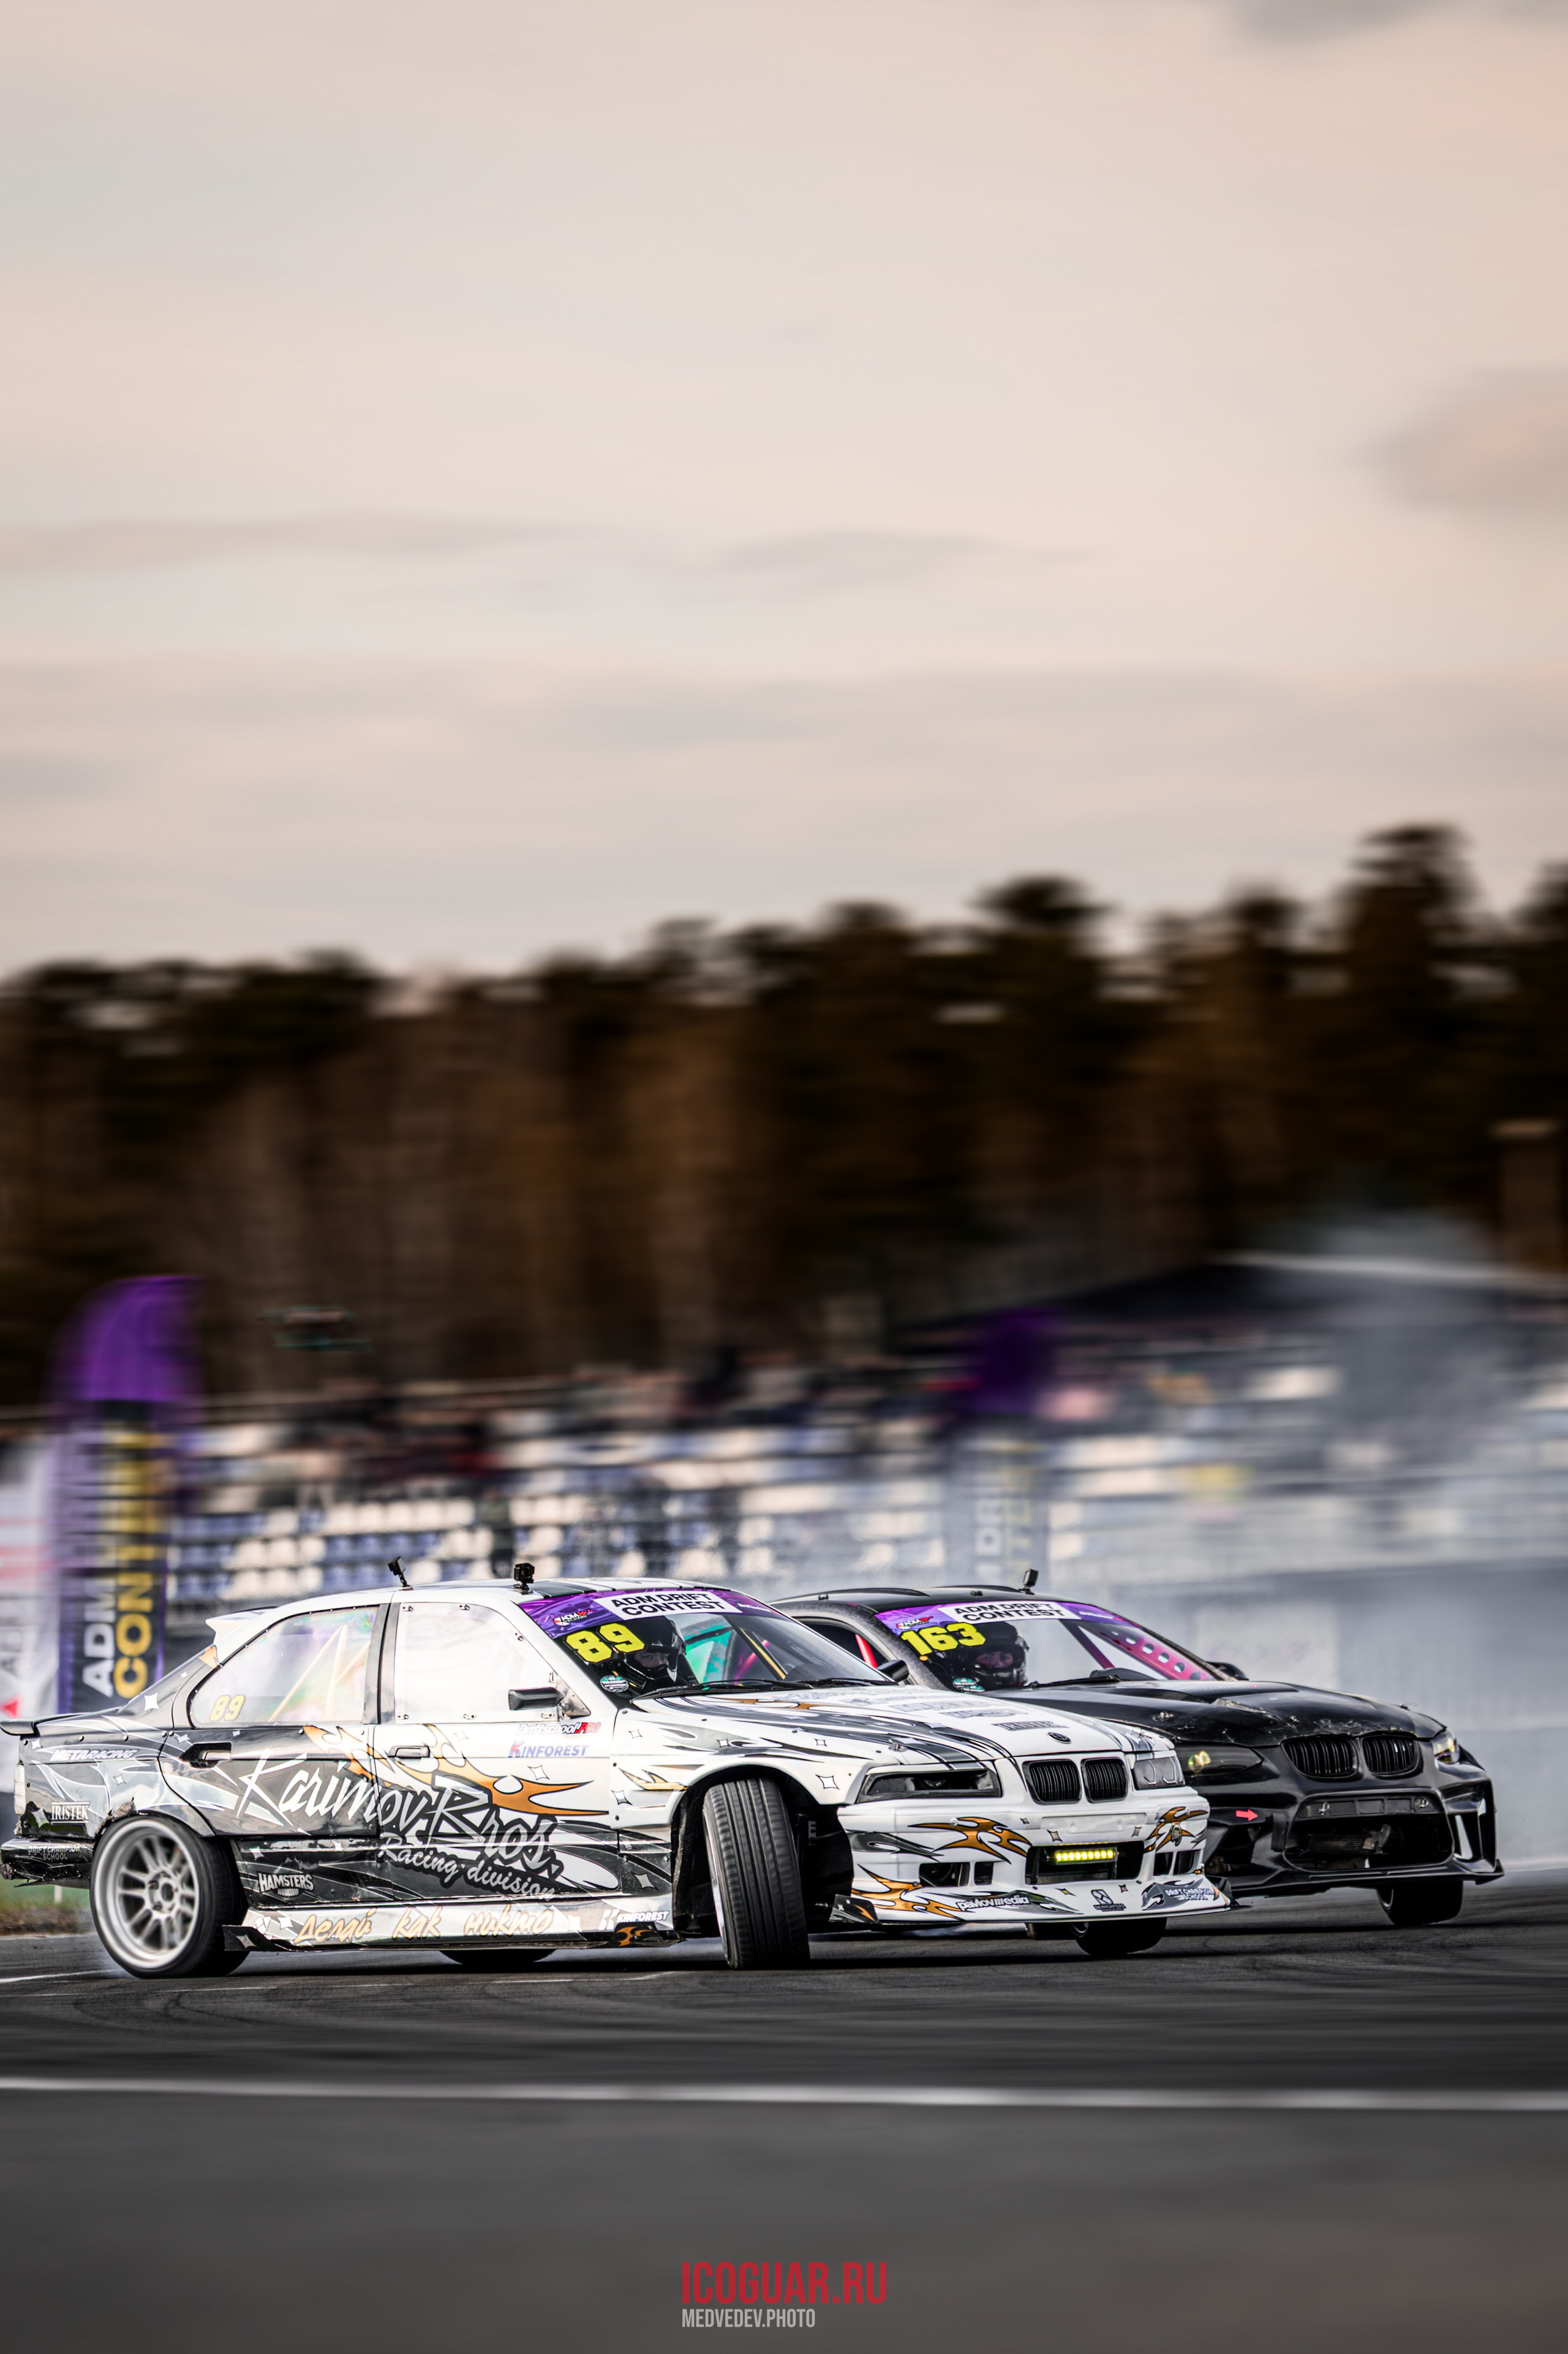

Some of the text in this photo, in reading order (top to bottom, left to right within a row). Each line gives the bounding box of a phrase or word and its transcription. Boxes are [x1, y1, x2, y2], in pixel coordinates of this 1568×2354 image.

[611, 1593, 712, 1607] ADM DRIFT
[621, 1601, 725, 1616] CONTEST
[954, 1603, 999, 1615] ADM
[962, 1609, 1066, 1621] CONTEST
[565, 1623, 645, 1663] 89
[901, 1623, 986, 1656] 163
[209, 1694, 246, 1722] 89
[50, 1749, 140, 1761] METARACING
[508, 1741, 589, 1758] KINFOREST
[51, 1805, 89, 1820] IRISTEK
[28, 1845, 48, 1854] DRIFT
[378, 1836, 556, 1901] Racing division
[258, 1873, 314, 1892] HAMSTERS
[277, 1888, 300, 1896] WORKSHOP
[616, 1911, 669, 1923] KINFOREST
